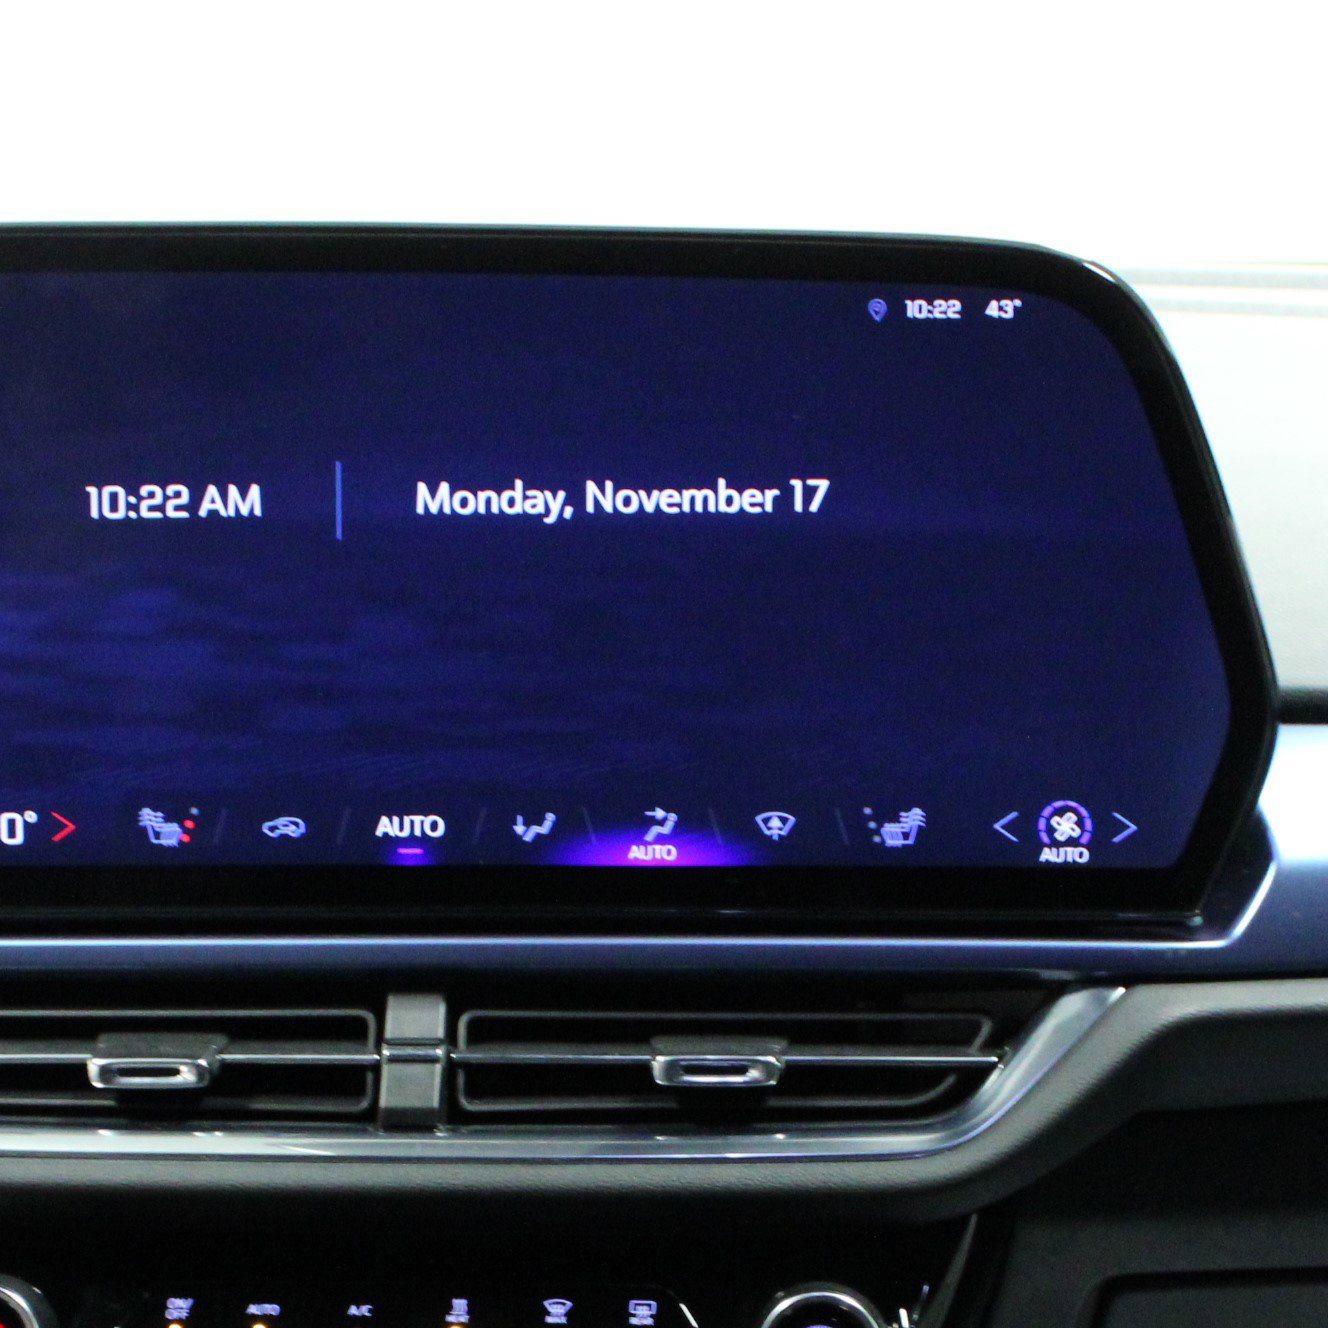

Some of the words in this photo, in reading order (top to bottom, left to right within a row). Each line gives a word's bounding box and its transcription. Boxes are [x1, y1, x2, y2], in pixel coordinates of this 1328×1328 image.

[904, 299, 962, 320] 10:22
[984, 298, 1023, 320] 43°
[85, 484, 191, 520] 10:22
[197, 483, 262, 518] AM
[415, 477, 574, 525] Monday,
[585, 477, 781, 515] November
[789, 478, 831, 514] 17
[375, 815, 446, 838] AUTO
[627, 845, 678, 862] AUTO
[1039, 846, 1090, 864] AUTO
[164, 1308, 190, 1320] OFF
[245, 1303, 281, 1316] AUTO
[347, 1304, 374, 1317] A/C
